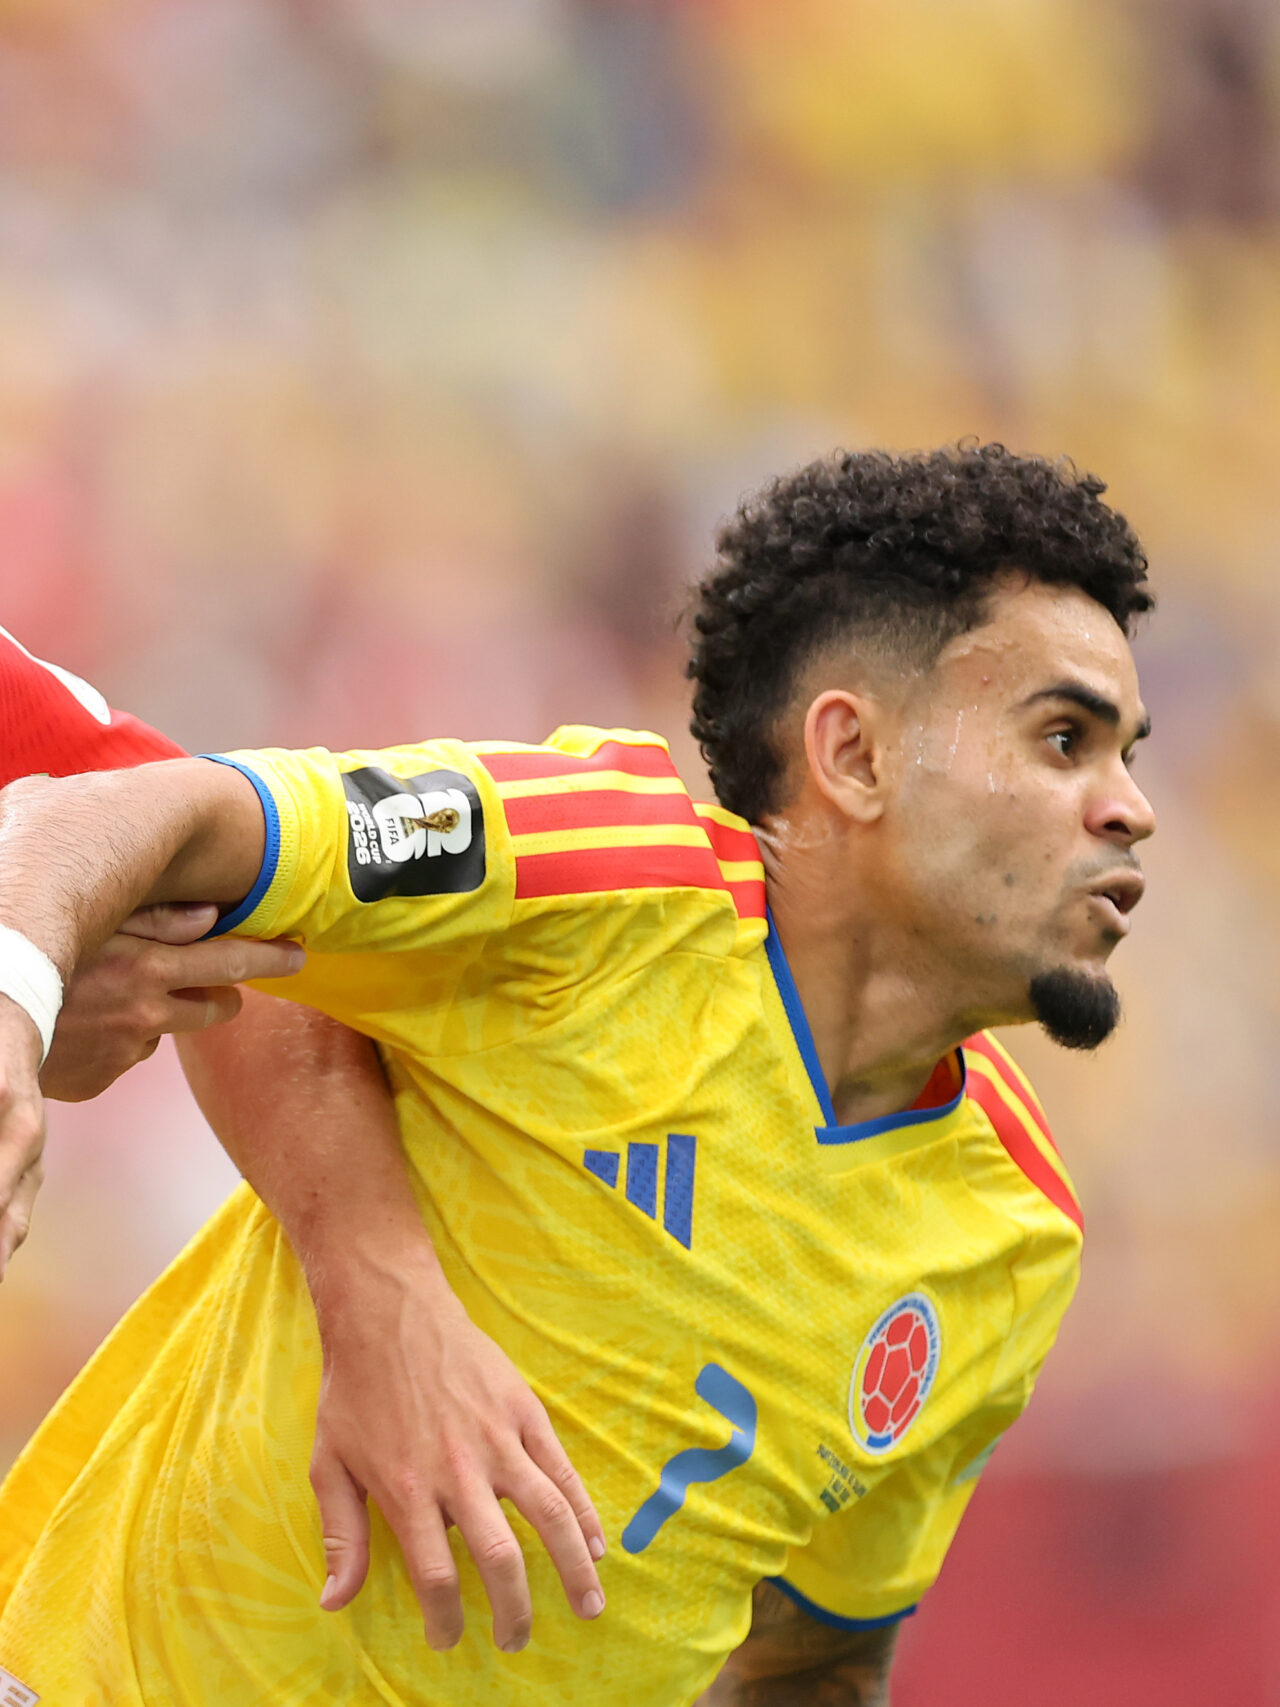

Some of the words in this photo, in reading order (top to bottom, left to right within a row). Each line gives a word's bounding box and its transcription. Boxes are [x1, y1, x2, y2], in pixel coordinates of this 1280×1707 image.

[345, 799, 371, 866] 2026
[369, 839, 382, 865] CUP
[384, 817, 400, 846] FIFA
[621, 1362, 758, 1555] 7
